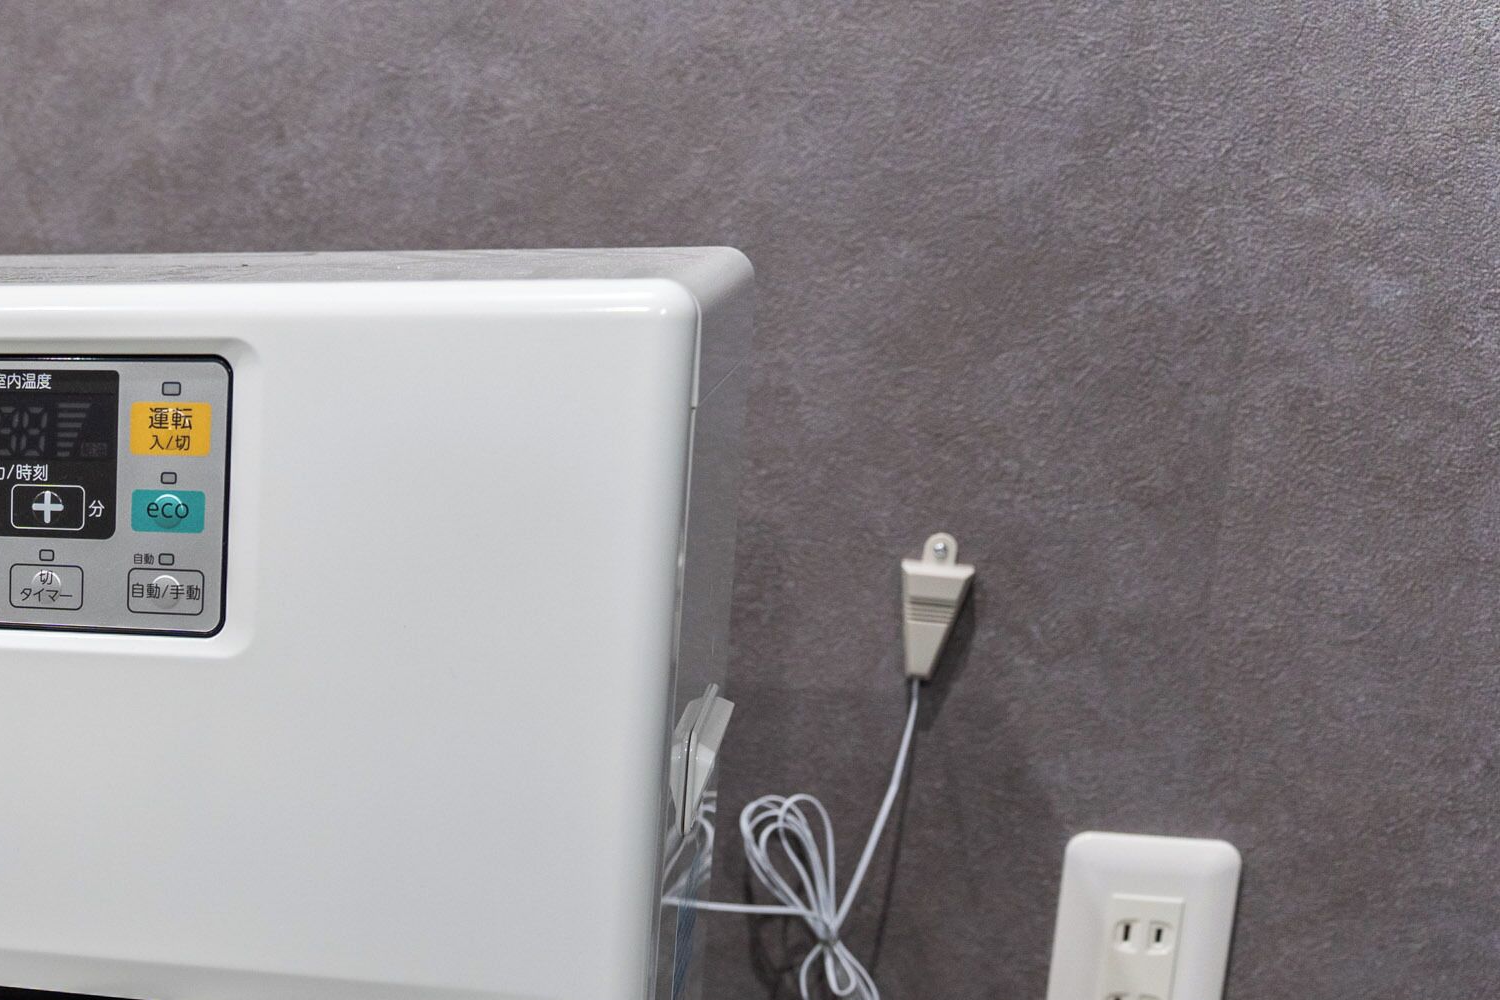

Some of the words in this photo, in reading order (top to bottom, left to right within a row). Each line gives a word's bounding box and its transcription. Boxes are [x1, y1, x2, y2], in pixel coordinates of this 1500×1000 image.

[148, 407, 193, 430] 運転
[149, 434, 191, 451] 入/切
[88, 500, 105, 518] 分
[146, 502, 190, 519] eco
[133, 553, 155, 566] 自動
[39, 570, 53, 586] 切
[20, 588, 73, 603] タイマー
[131, 582, 201, 601] 自動/手動
